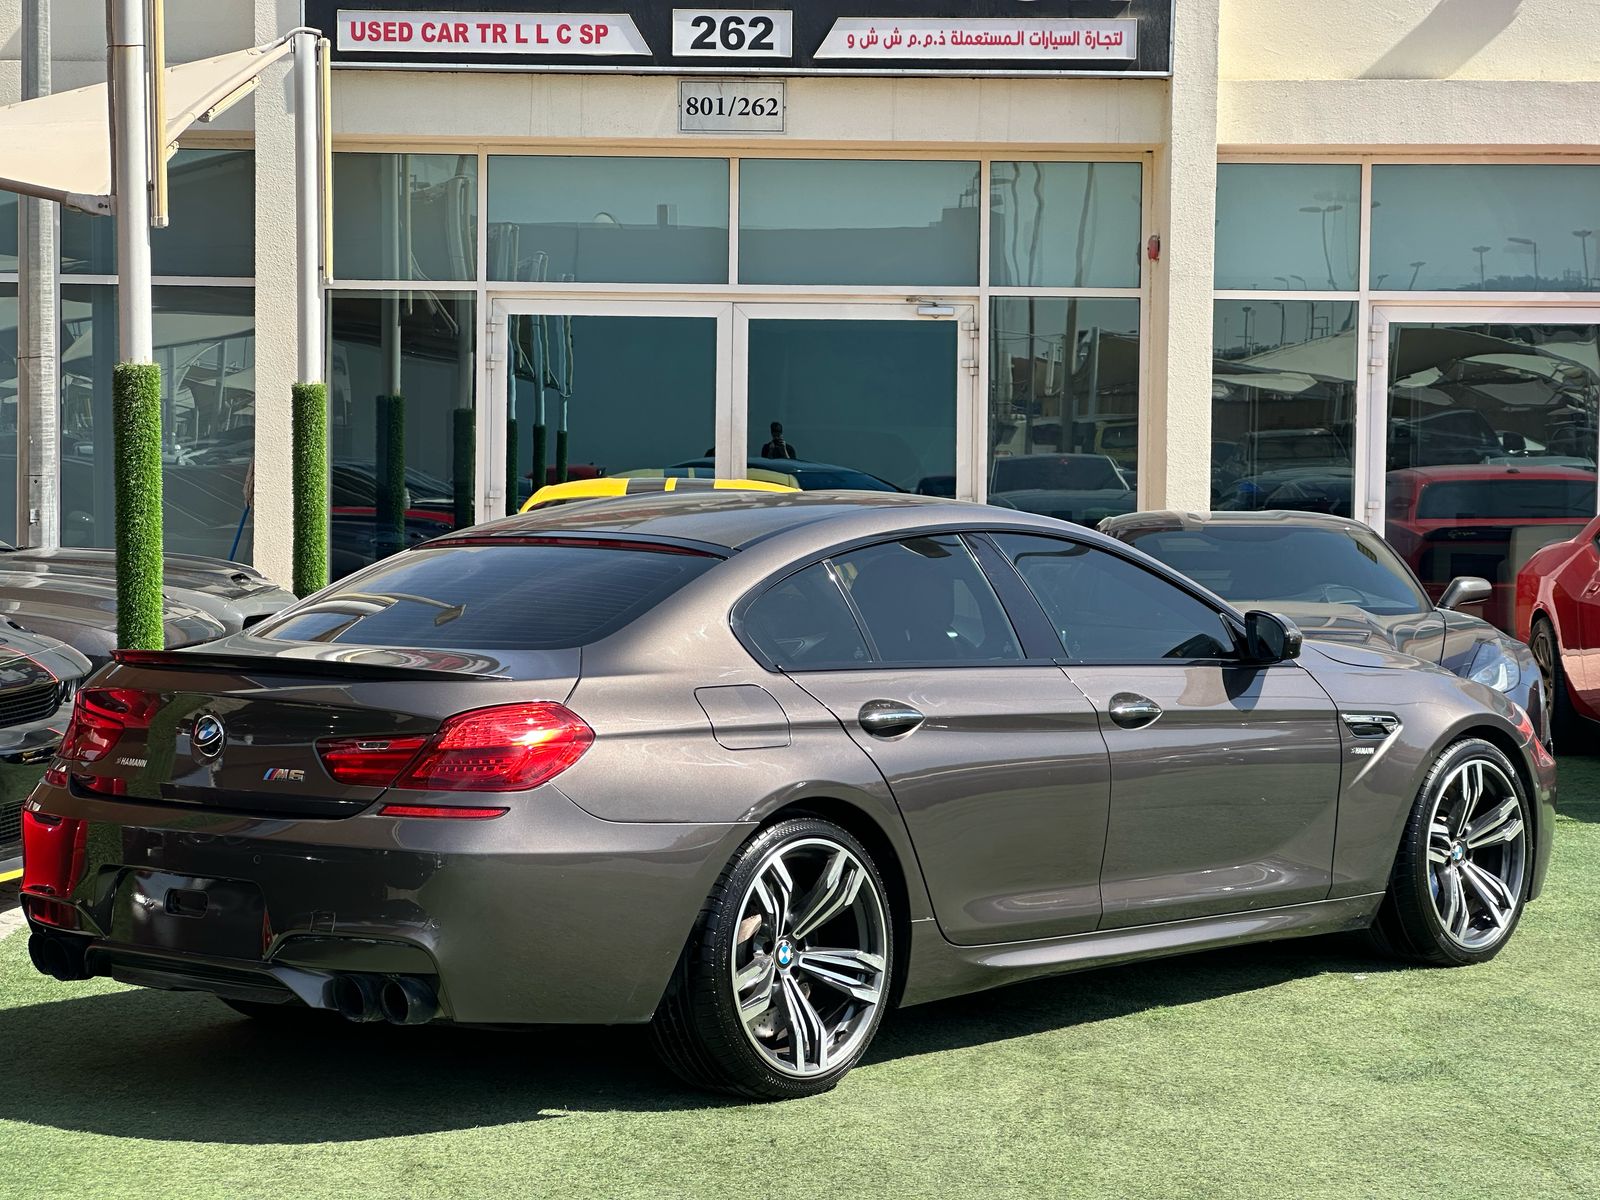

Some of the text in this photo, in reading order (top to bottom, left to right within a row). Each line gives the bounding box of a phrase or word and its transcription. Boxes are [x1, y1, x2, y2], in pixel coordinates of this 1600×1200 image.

[350, 21, 414, 43] USED
[420, 21, 469, 44] CAR
[475, 22, 507, 44] TR
[579, 24, 609, 45] SP
[690, 15, 774, 50] 262
[950, 30, 1024, 46] المستعملة
[1029, 30, 1080, 50] السيارات
[1084, 30, 1123, 50] لتجارة
[685, 95, 779, 119] 801/262
[120, 757, 148, 768] HAMANN
